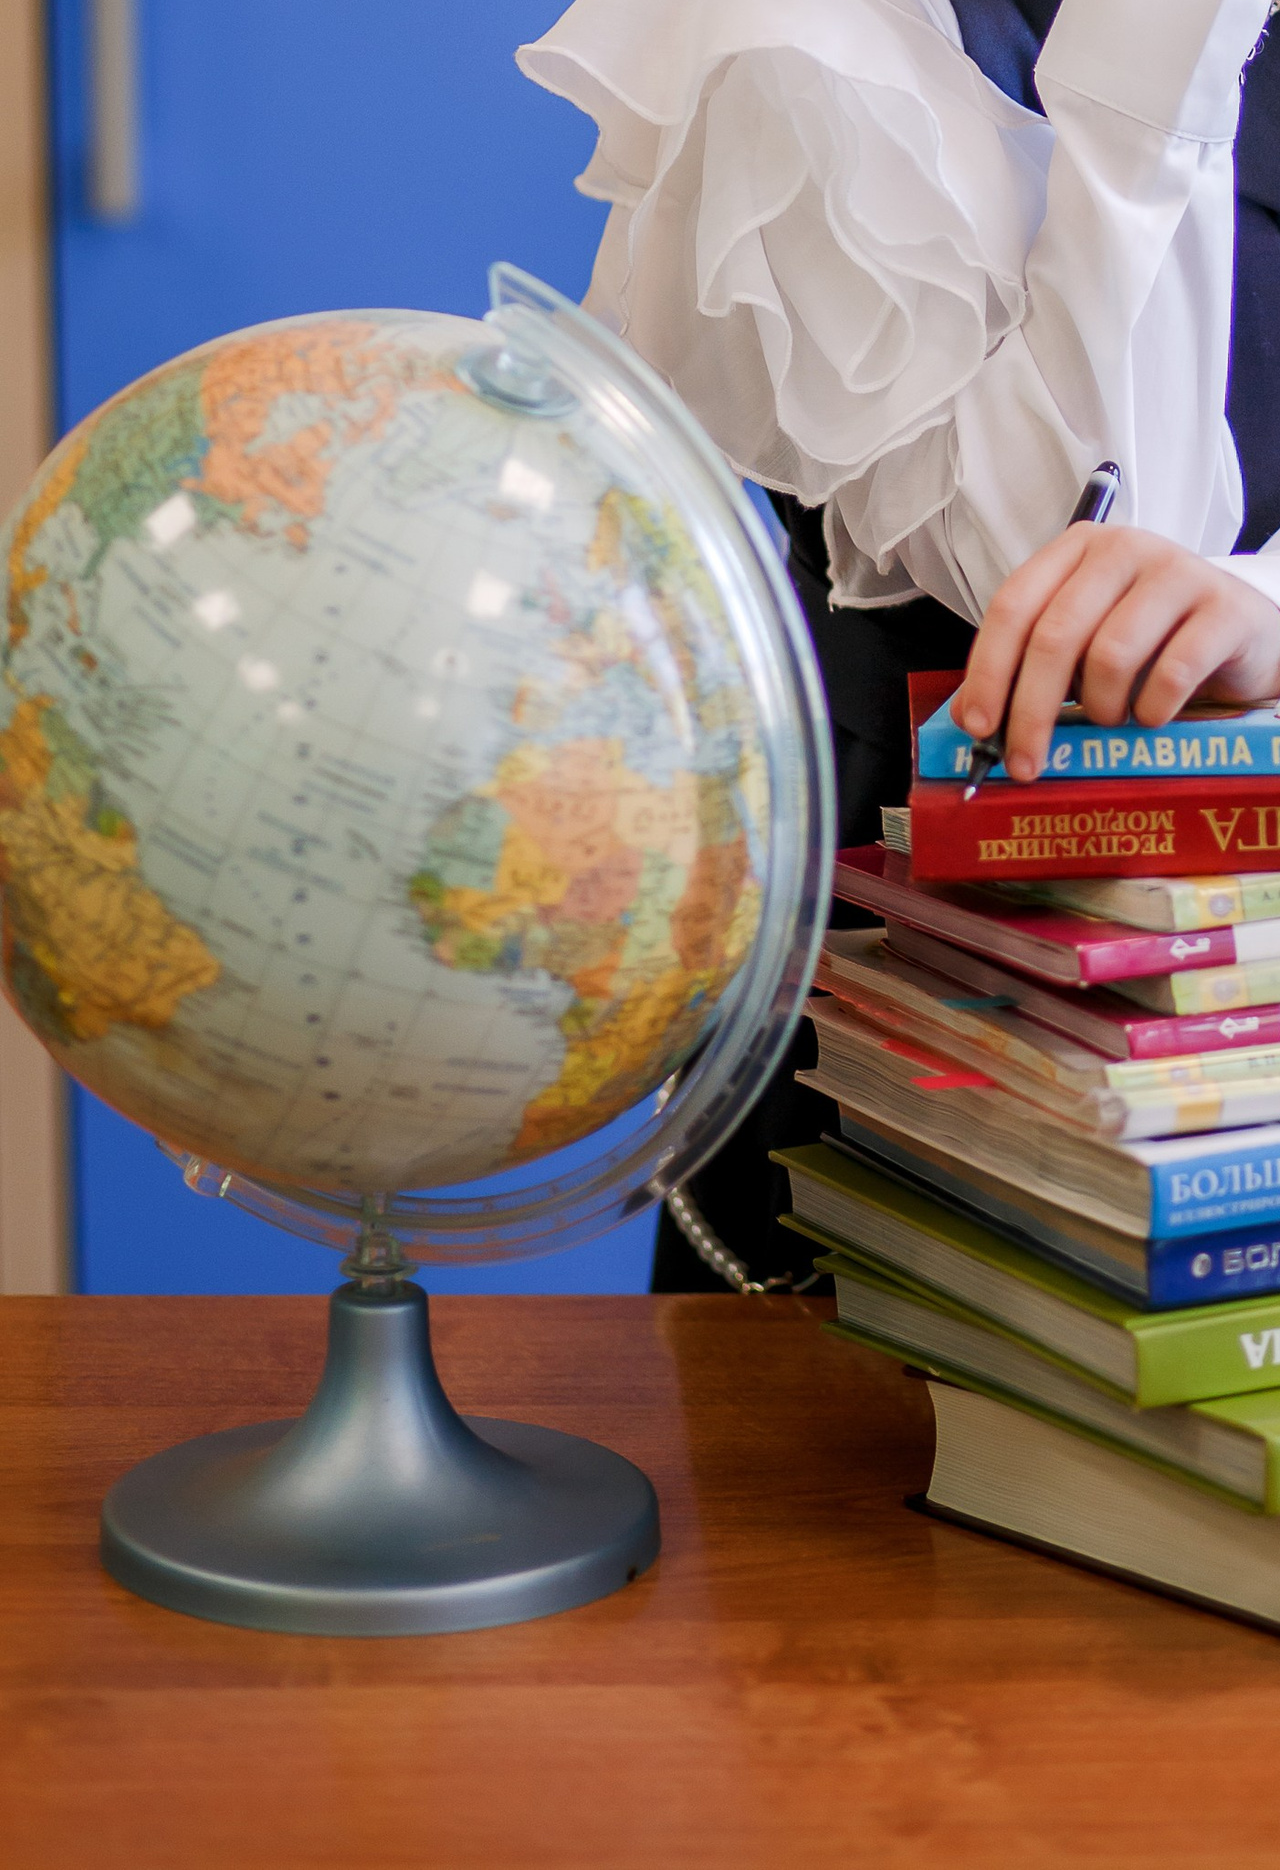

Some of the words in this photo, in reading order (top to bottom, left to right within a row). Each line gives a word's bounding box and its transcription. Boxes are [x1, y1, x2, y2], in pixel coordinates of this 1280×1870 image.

[1082, 735, 1253, 770] ПРАВИЛА
[1011, 809, 1176, 838] МОРДОВИЯ
[978, 833, 1176, 861] РЕСПУБЛИКИ
